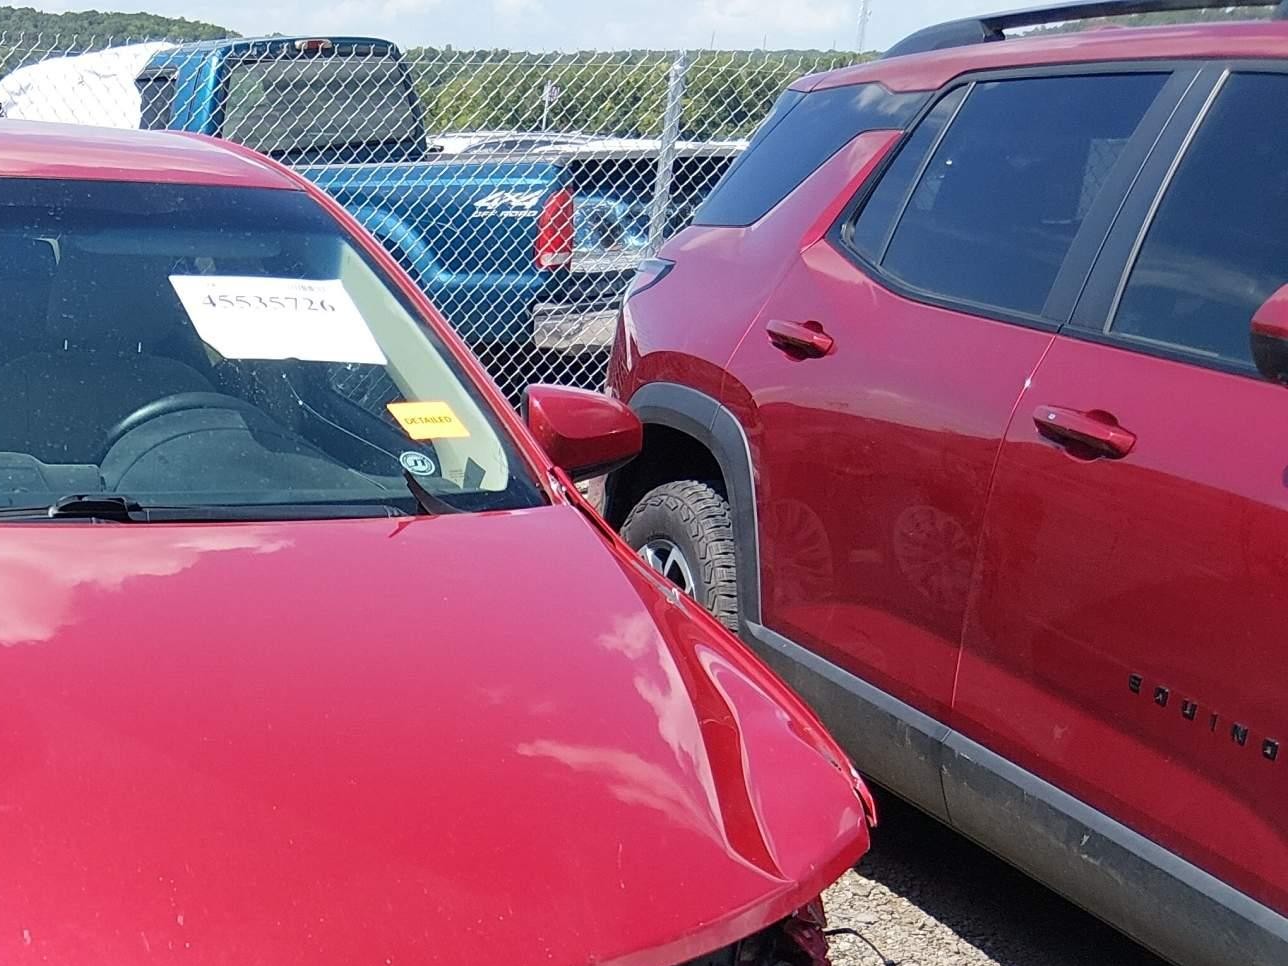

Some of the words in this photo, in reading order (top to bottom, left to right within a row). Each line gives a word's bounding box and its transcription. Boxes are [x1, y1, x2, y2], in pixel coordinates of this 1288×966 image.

[499, 210, 539, 218] ROAD
[202, 294, 336, 312] 45535726
[403, 415, 453, 425] DETAILED
